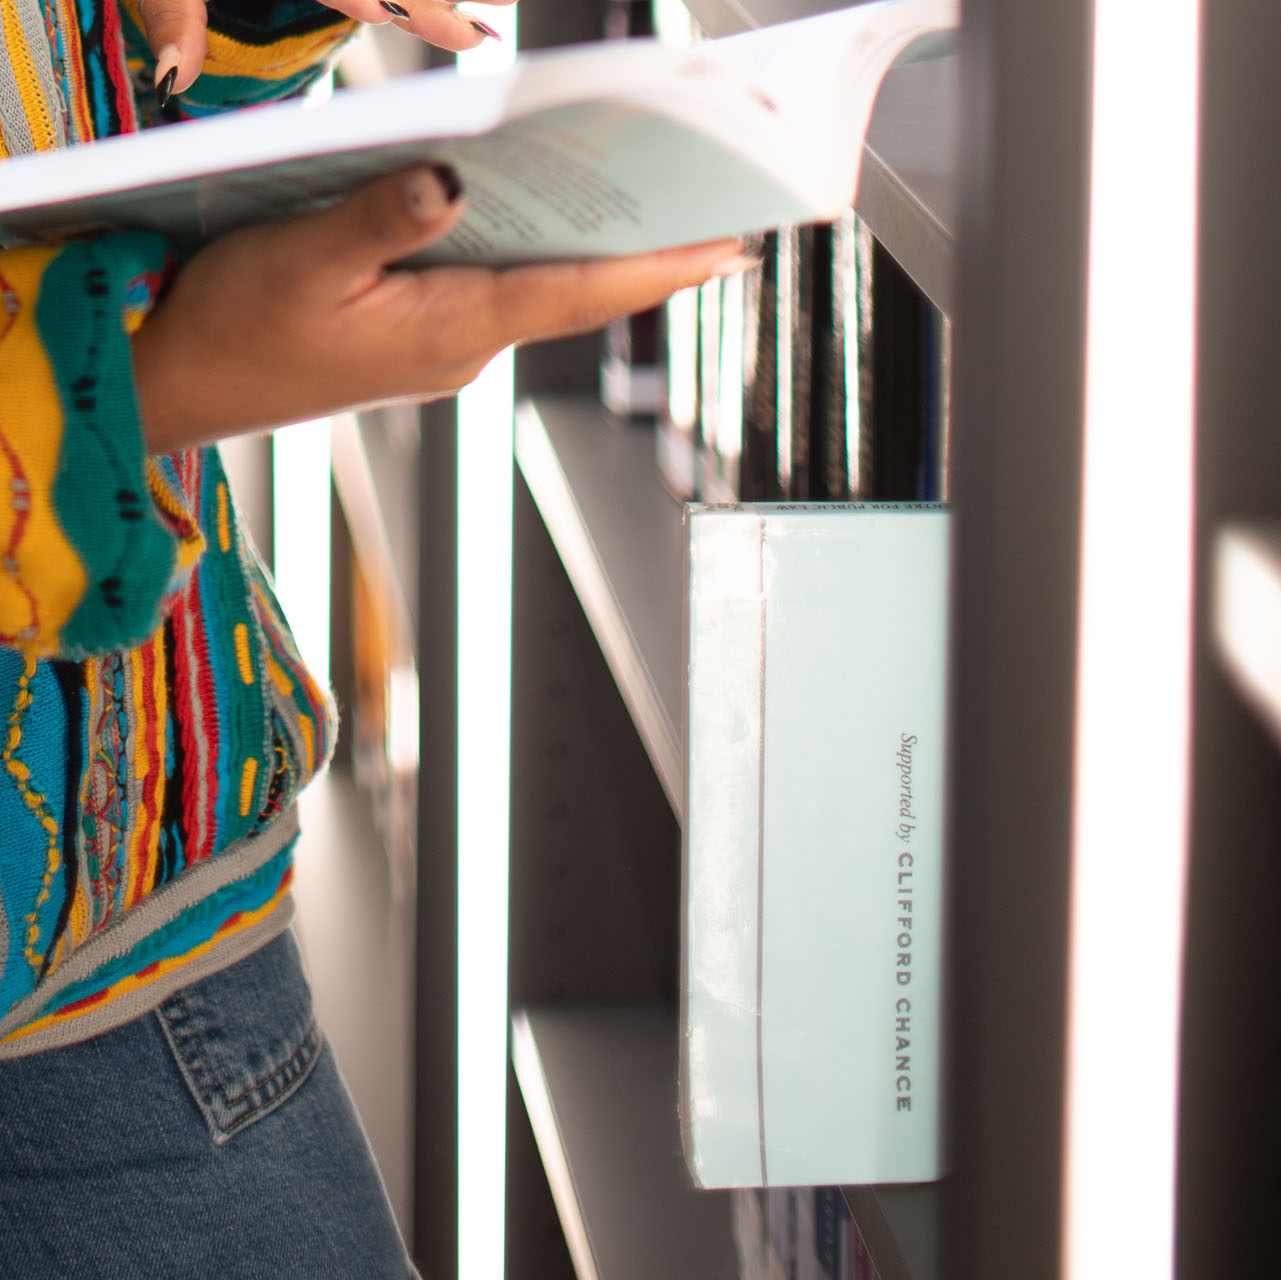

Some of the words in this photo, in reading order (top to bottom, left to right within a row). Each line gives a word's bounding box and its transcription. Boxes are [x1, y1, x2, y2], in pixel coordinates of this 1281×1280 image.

[896, 732, 918, 820] Supported
[895, 823, 917, 843] by
[896, 852, 914, 986] CLIFFORD
[895, 998, 912, 1112] CHANCE
